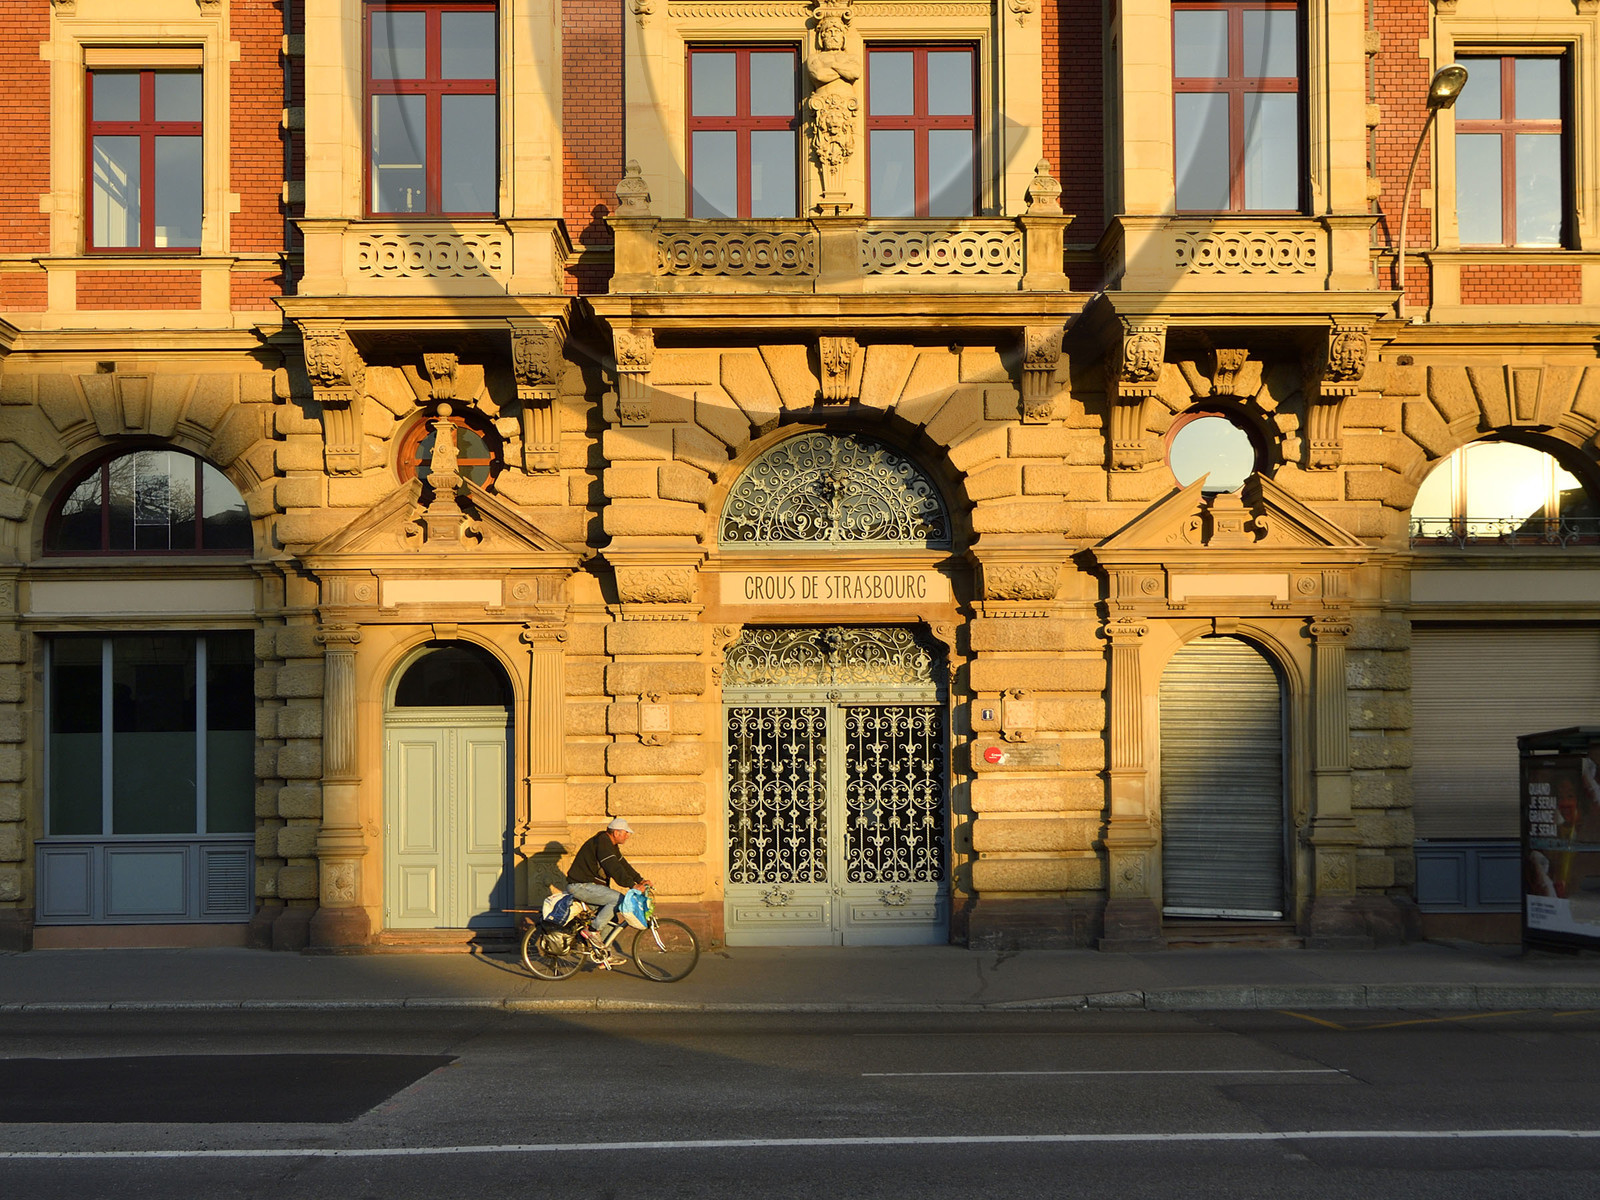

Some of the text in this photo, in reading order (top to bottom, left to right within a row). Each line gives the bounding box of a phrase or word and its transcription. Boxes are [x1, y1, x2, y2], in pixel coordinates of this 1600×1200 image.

[745, 574, 926, 600] CROUS DE STRASBOURG
